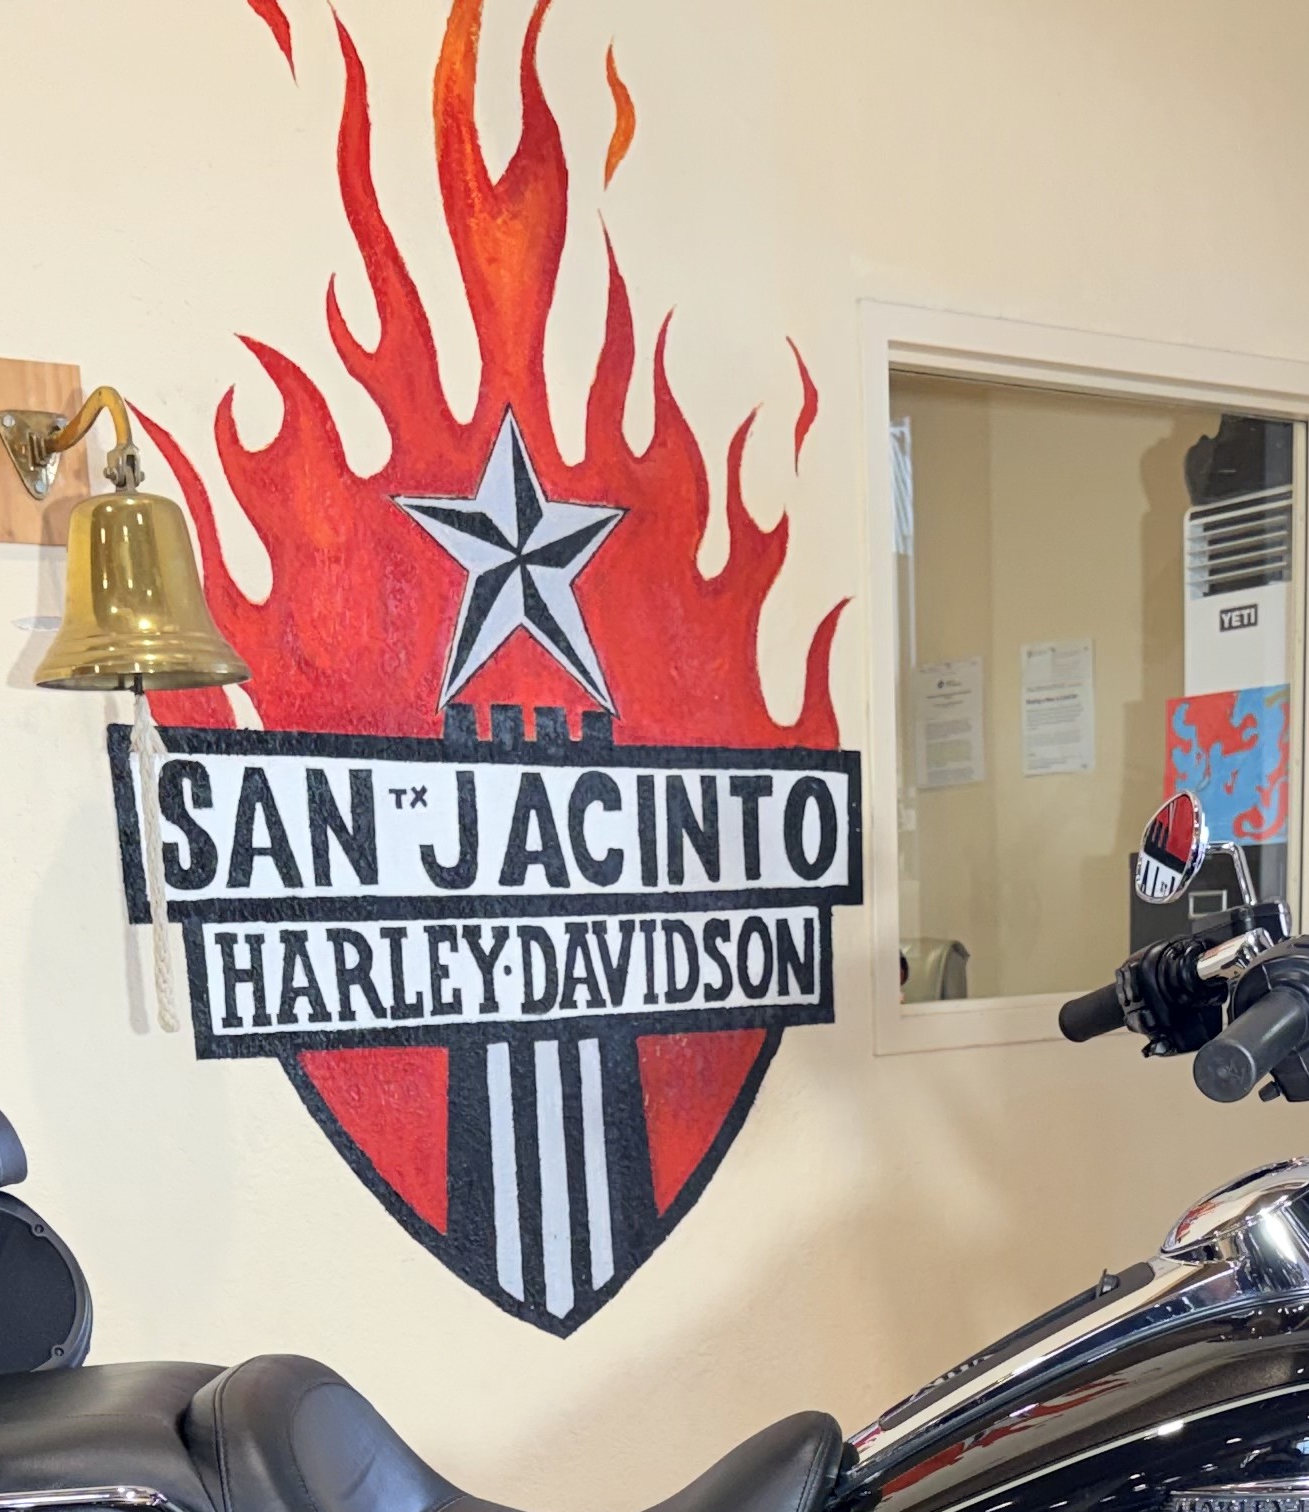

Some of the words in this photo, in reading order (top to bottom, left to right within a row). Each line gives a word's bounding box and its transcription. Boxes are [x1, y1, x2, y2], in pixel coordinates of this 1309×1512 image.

[1221, 607, 1256, 629] YETI
[158, 759, 379, 890] SAN
[389, 785, 428, 810] TX
[420, 770, 837, 890] JACINTO
